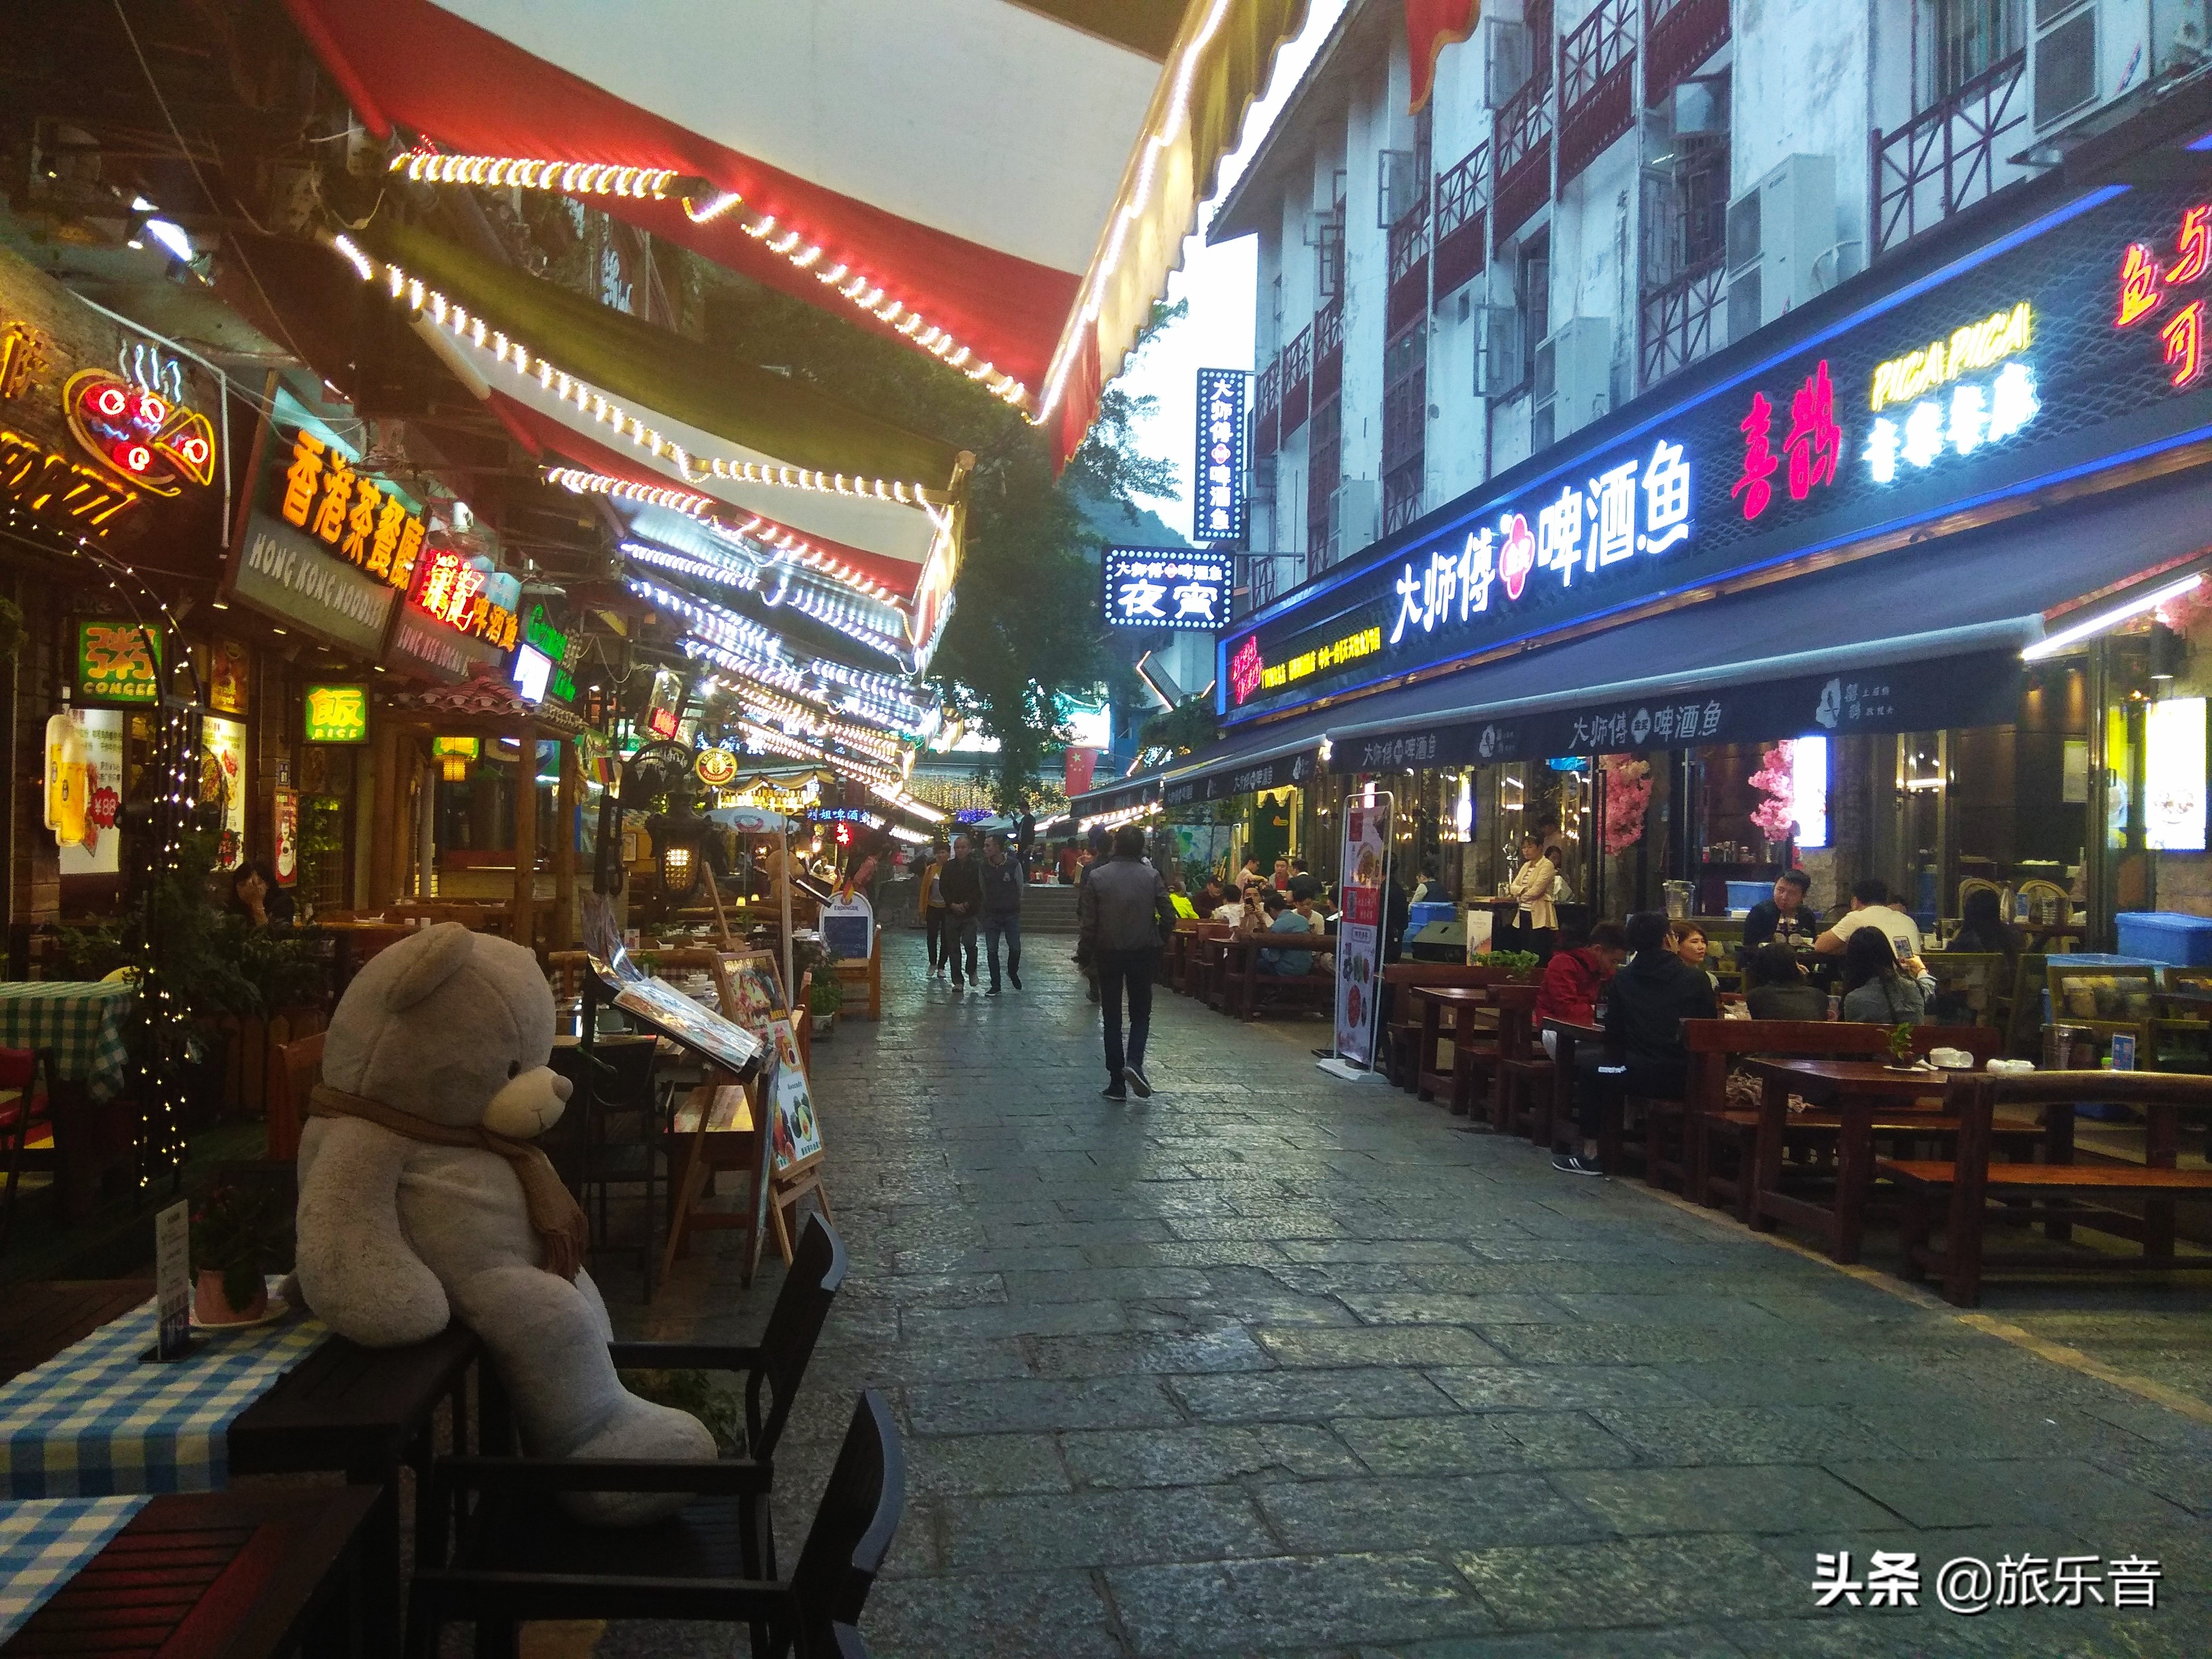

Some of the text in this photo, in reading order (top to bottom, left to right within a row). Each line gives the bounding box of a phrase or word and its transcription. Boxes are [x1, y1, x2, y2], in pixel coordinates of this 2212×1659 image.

[1871, 301, 2032, 412] PICA PICA
[1731, 359, 1842, 521] 喜鹊
[282, 429, 425, 591] 香港茶餐廳
[1390, 440, 1691, 645] 大师傅 啤酒鱼
[248, 533, 297, 589] HONG
[295, 559, 336, 607] KONG
[1118, 578, 1218, 621] 夜宵
[82, 682, 157, 696] CONGEE
[308, 688, 363, 727] 飯
[314, 728, 358, 739] RICE
[1654, 700, 1722, 742] 啤酒鱼
[95, 798, 116, 816] ¥88
